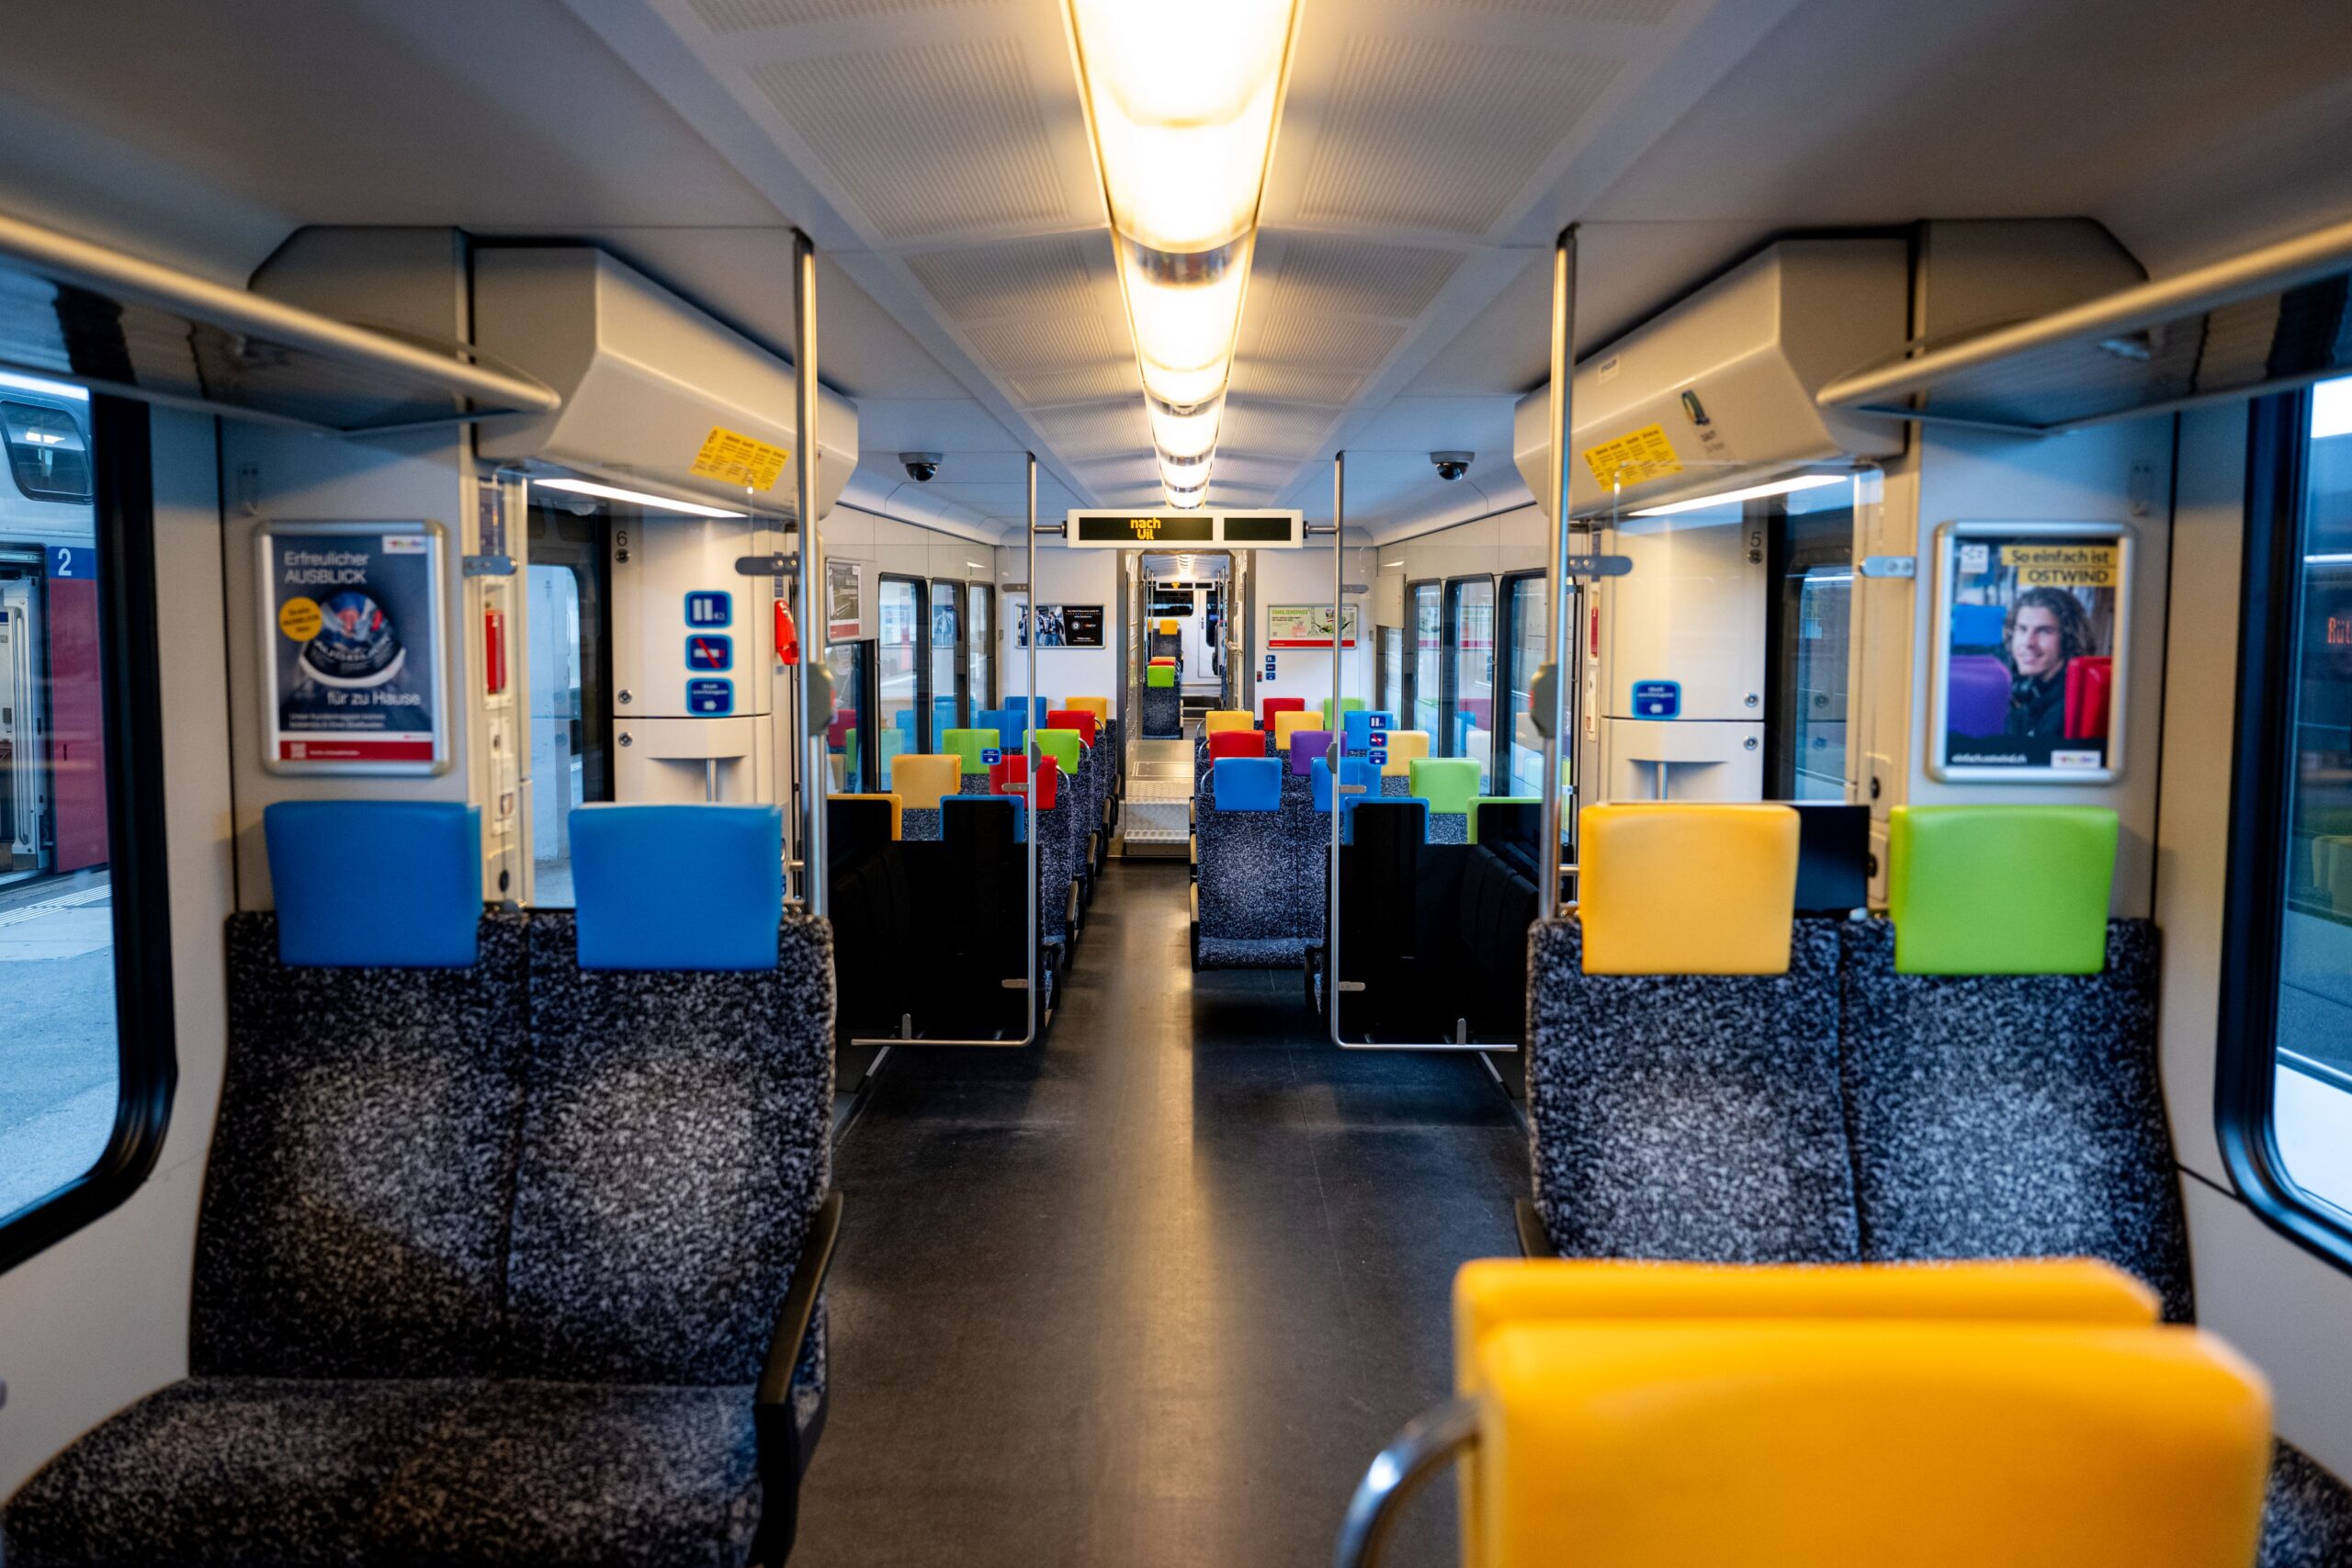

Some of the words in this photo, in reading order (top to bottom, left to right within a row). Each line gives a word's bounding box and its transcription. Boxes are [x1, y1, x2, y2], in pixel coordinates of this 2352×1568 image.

[1130, 517, 1161, 529] nach
[616, 530, 628, 547] 6
[1136, 528, 1155, 540] Wil
[1750, 531, 1761, 547] 5
[58, 547, 73, 577] 2
[284, 551, 369, 566] Erfreulicher
[2011, 549, 2030, 563] So
[2032, 548, 2087, 563] einfach
[2091, 548, 2109, 563] ist
[284, 569, 368, 584] AUSBLICK
[2028, 570, 2109, 583] OSTWIND
[2327, 616, 2352, 644] Rüt
[327, 690, 348, 705] für
[350, 693, 369, 705] zu
[372, 691, 422, 705] Hause
